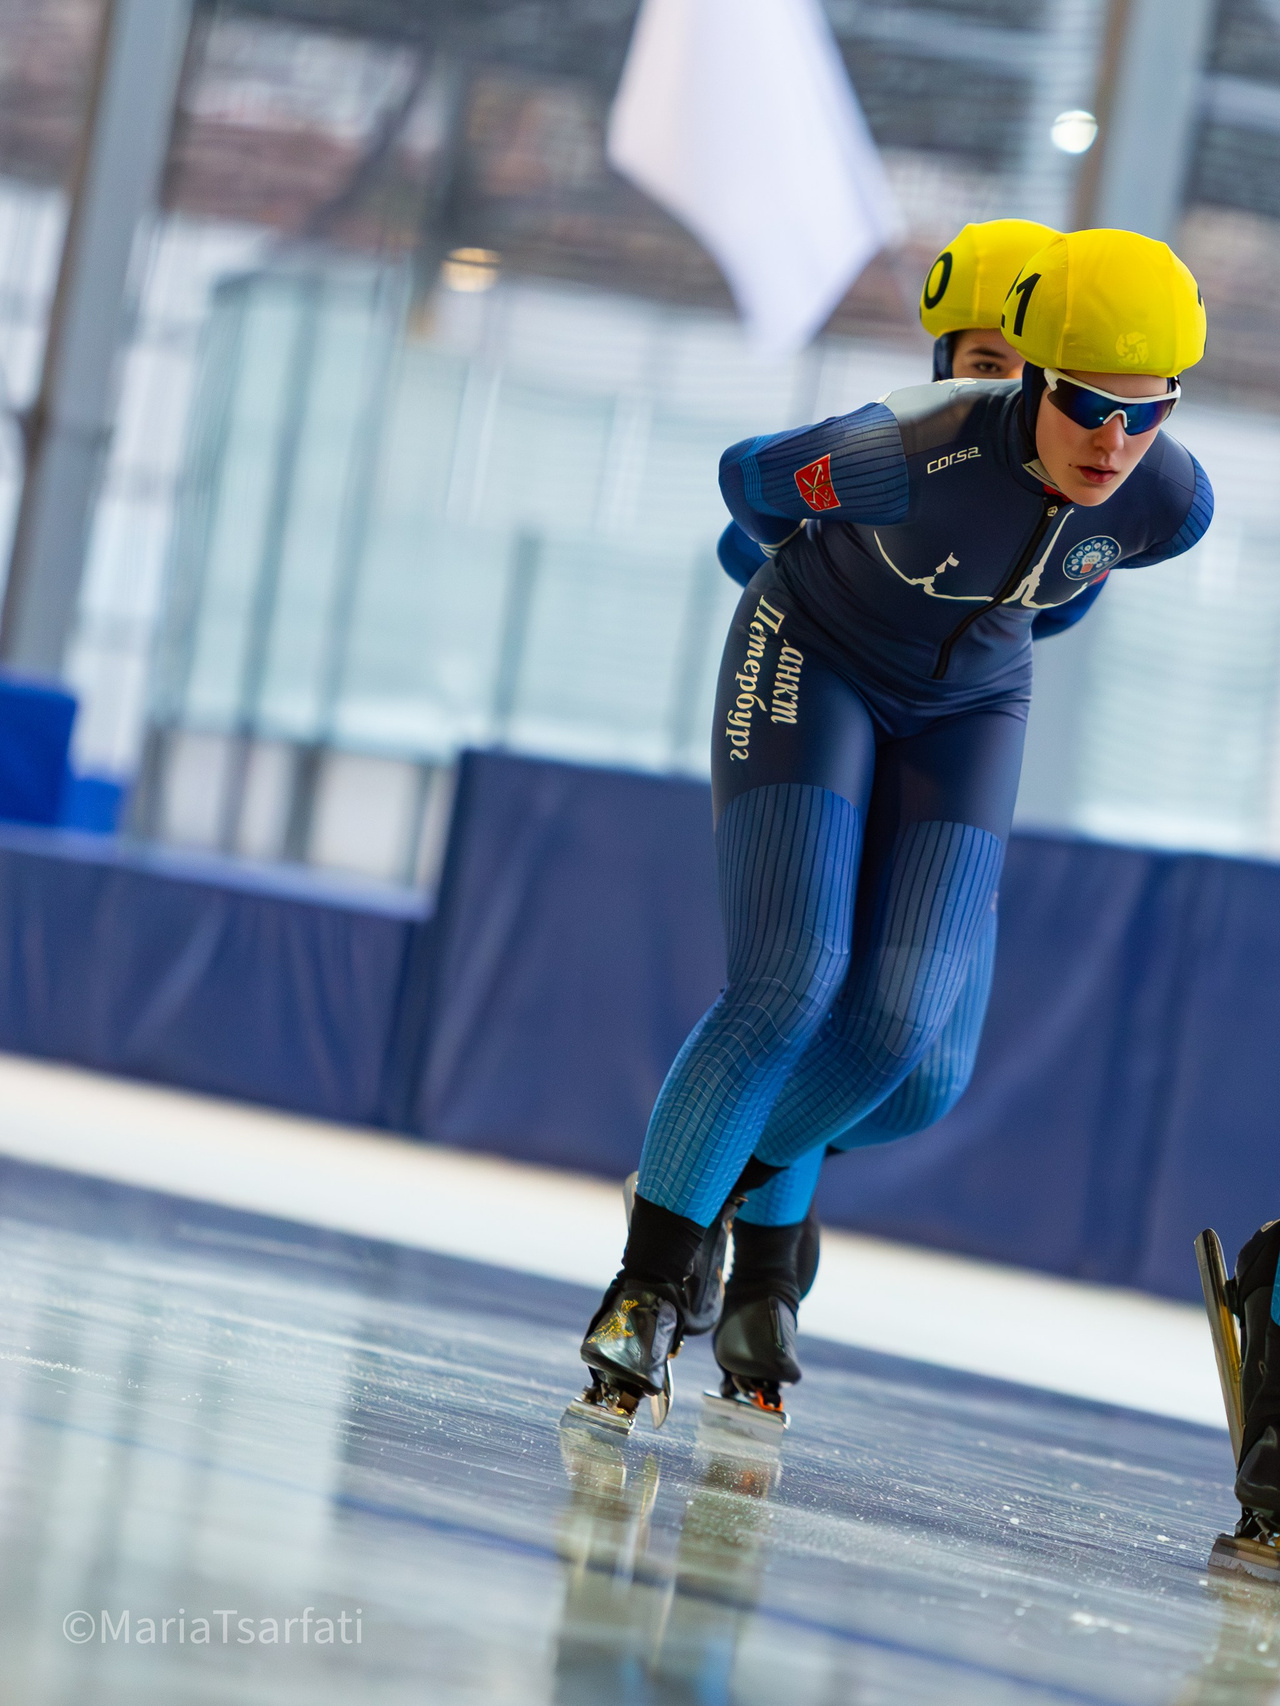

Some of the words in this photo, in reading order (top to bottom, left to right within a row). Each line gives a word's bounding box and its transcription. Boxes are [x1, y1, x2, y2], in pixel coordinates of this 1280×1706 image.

[1001, 265, 1042, 337] 1
[927, 446, 982, 474] corsa
[770, 639, 804, 724] анкт
